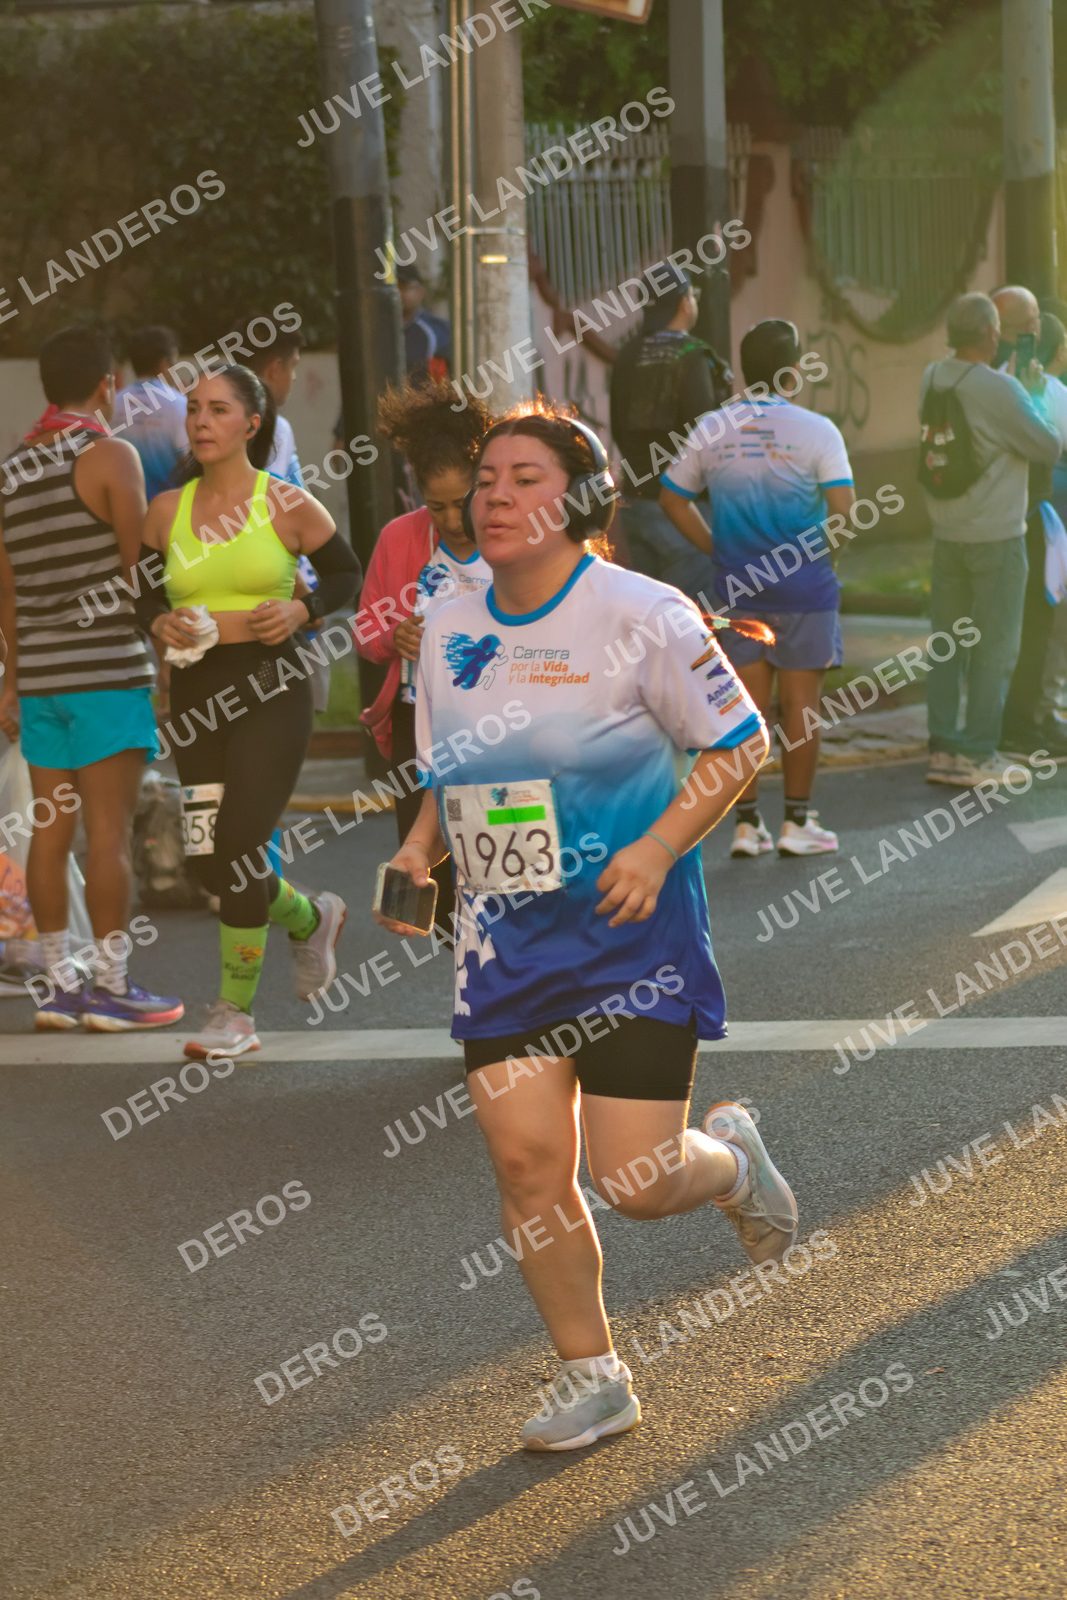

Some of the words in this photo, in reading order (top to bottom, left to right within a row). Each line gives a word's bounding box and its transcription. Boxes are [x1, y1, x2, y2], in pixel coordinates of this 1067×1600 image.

[513, 646, 570, 660] Carrera
[510, 662, 528, 673] por
[531, 661, 542, 670] la
[543, 660, 568, 671] Vida
[508, 674, 515, 685] y
[516, 671, 527, 684] la
[529, 672, 590, 687] Integridad
[455, 828, 554, 878] 1963
